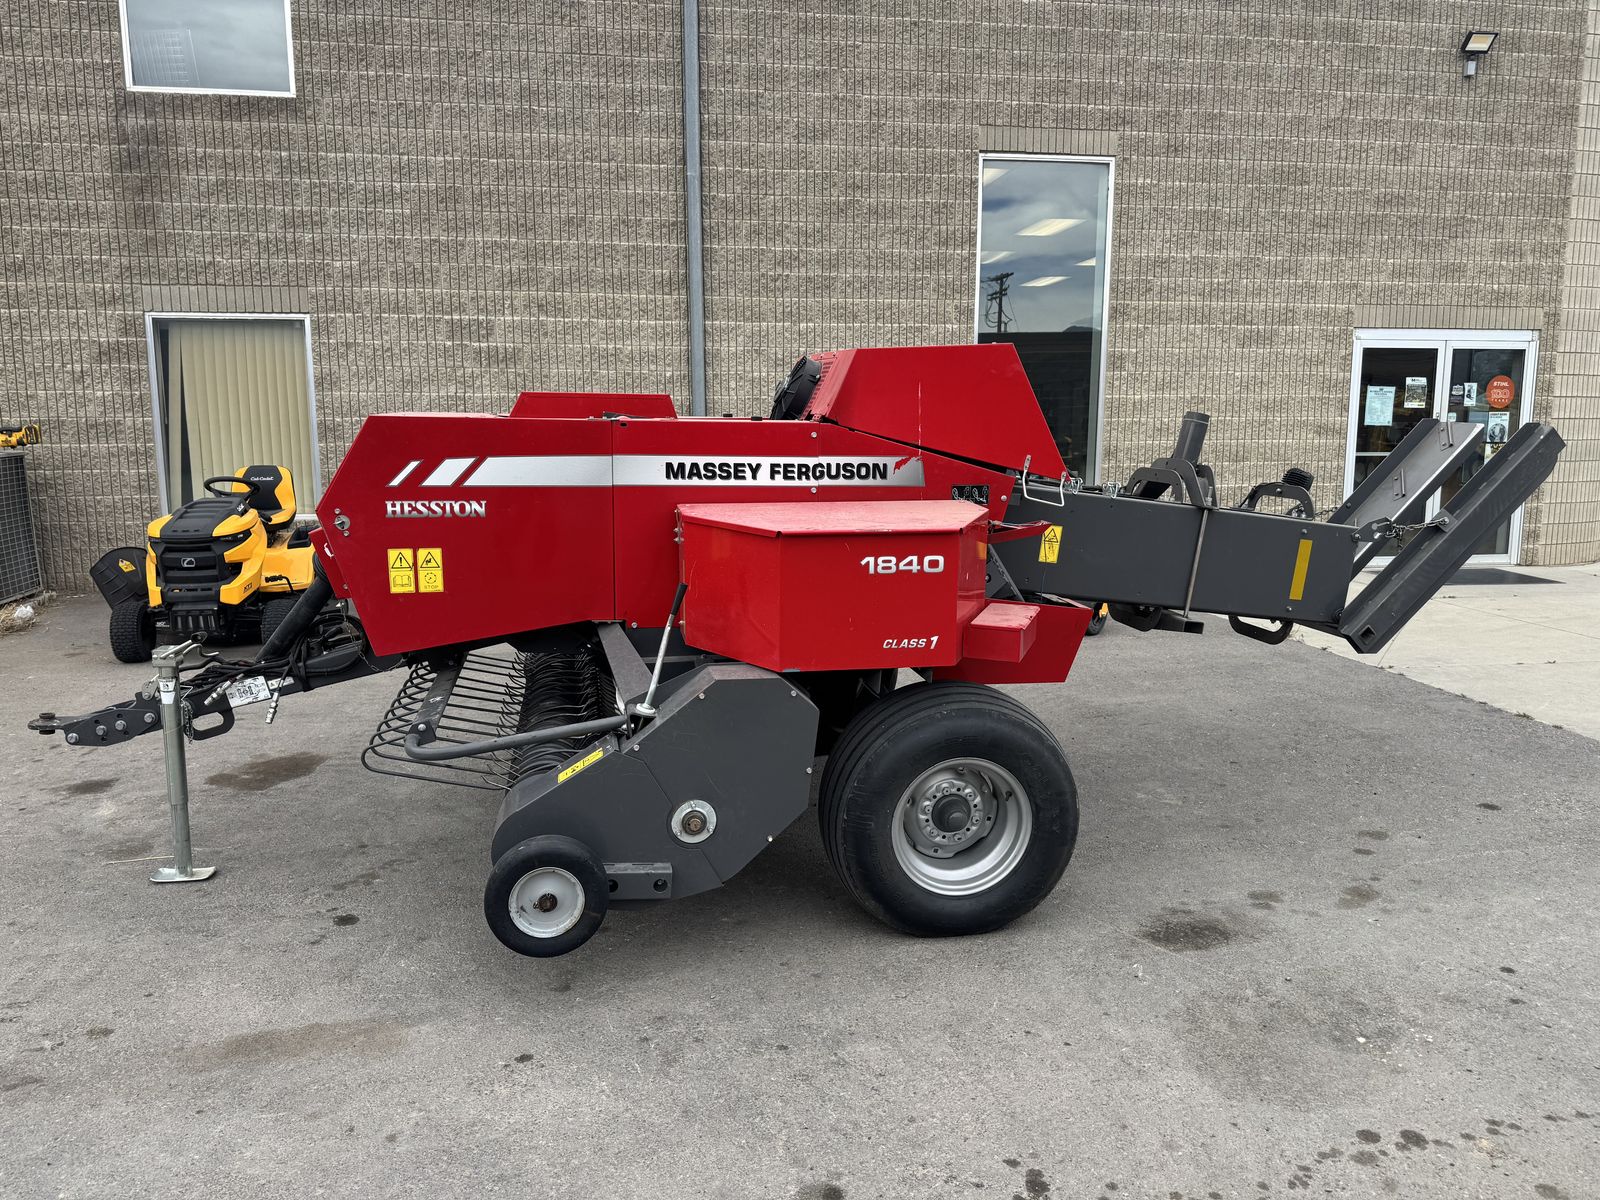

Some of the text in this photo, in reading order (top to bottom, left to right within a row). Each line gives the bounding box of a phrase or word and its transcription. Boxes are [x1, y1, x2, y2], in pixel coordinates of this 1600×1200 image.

[1491, 389, 1510, 398] 100
[665, 462, 888, 480] MASSEY FERGUSON
[385, 500, 487, 518] HESSTON
[860, 555, 945, 574] 1840
[882, 635, 939, 650] CLASS 1
